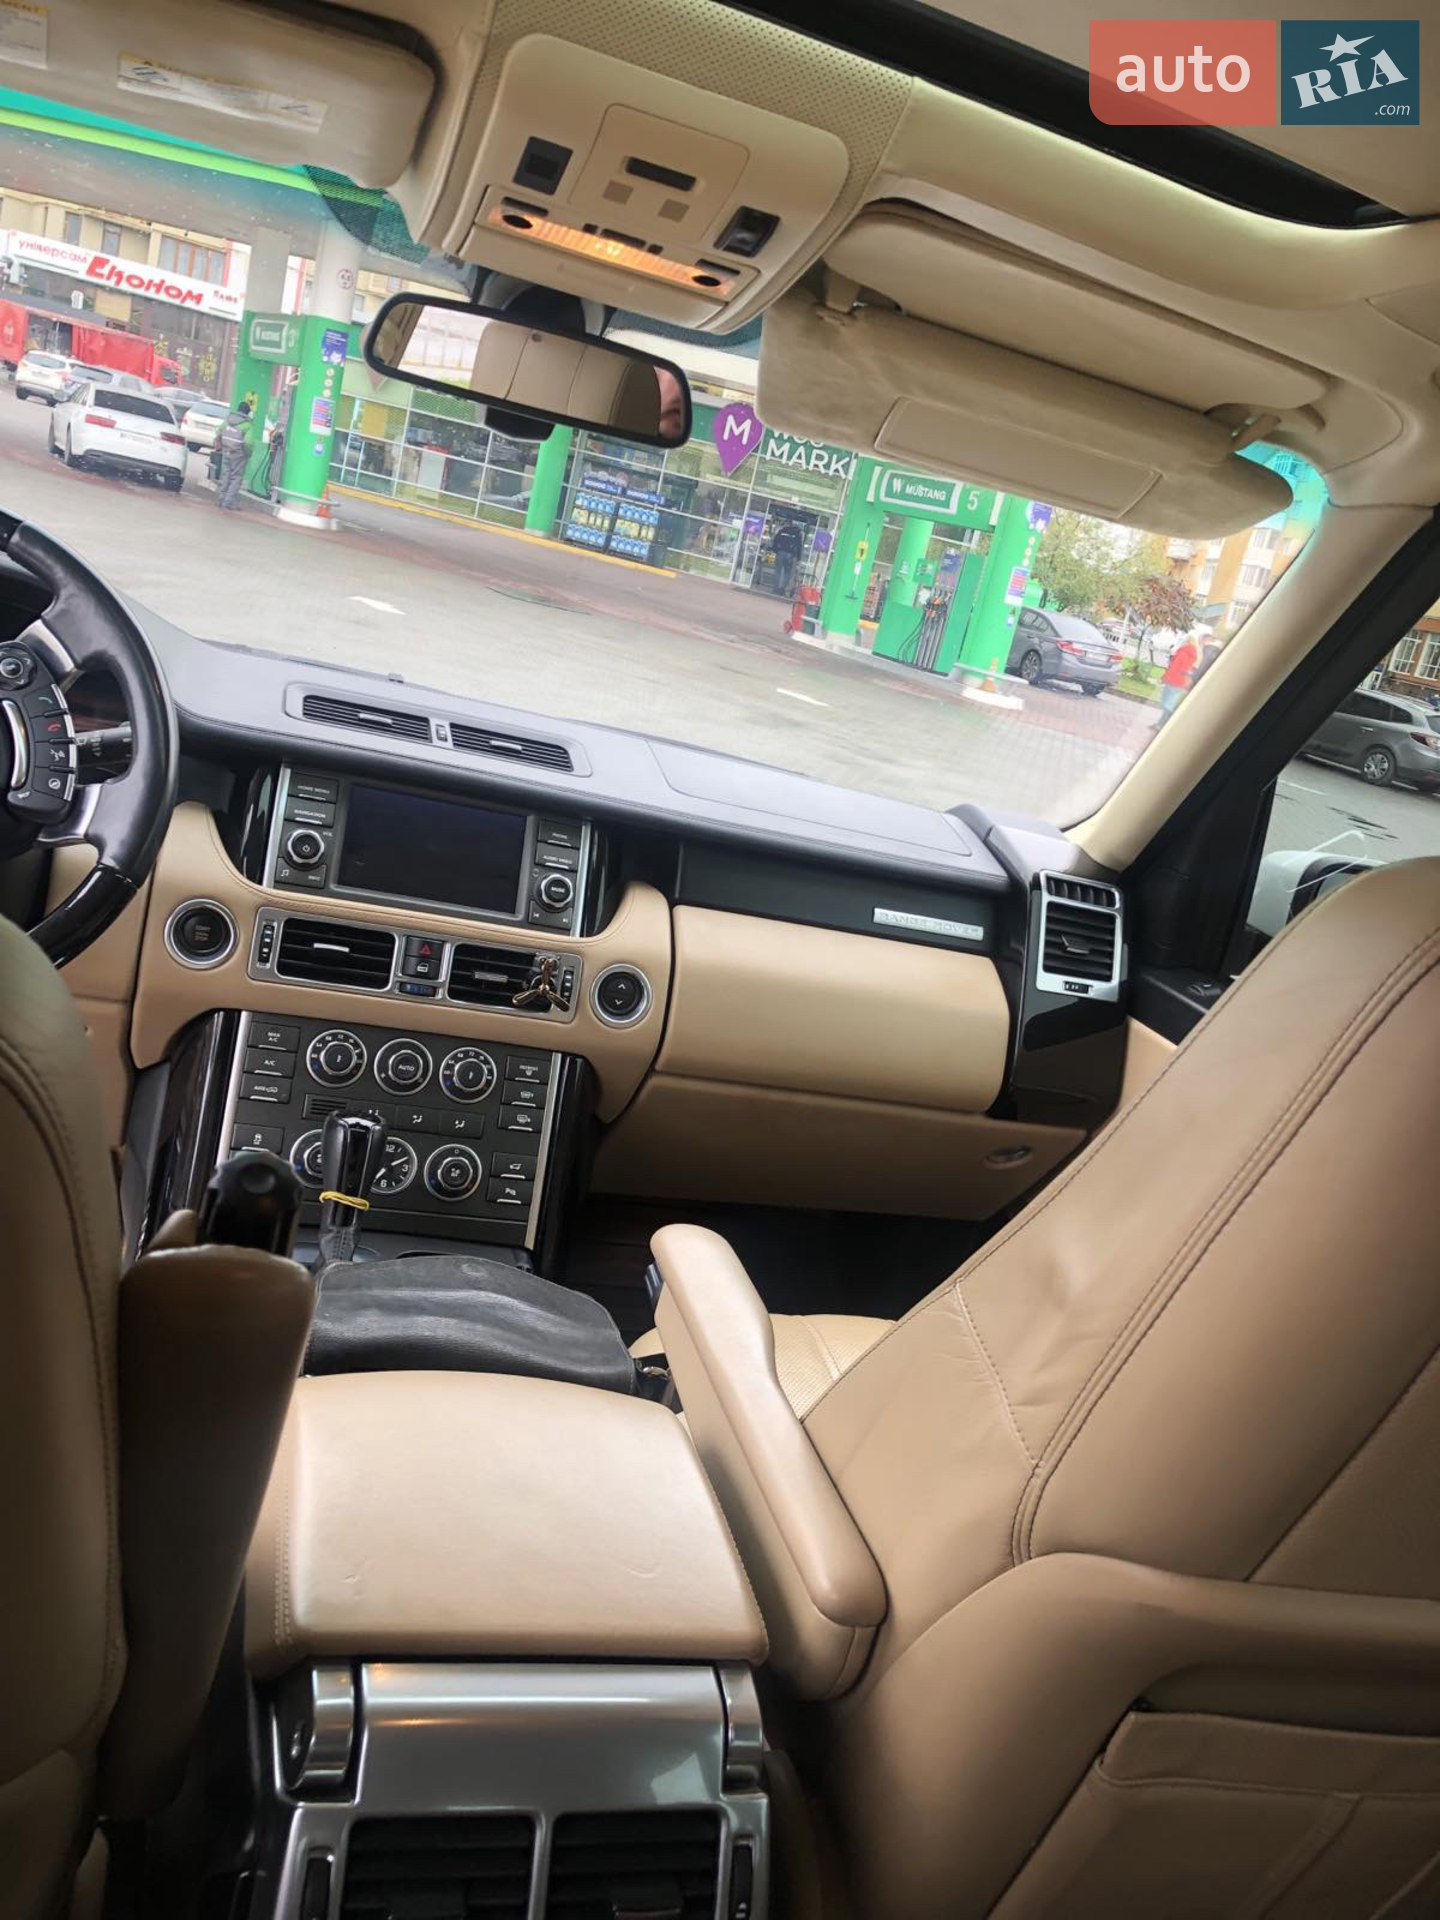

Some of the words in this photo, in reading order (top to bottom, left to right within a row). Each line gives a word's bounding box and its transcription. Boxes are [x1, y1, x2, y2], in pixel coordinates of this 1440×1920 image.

[722, 414, 752, 446] M
[765, 438, 850, 480] MARK
[905, 483, 947, 501] MUSTANG
[967, 490, 980, 511] 5
[263, 1059, 276, 1067] A/C
[397, 1063, 415, 1072] AUTO
[385, 1144, 396, 1153] 12
[401, 1163, 409, 1173] 3
[380, 1178, 388, 1189] 6
